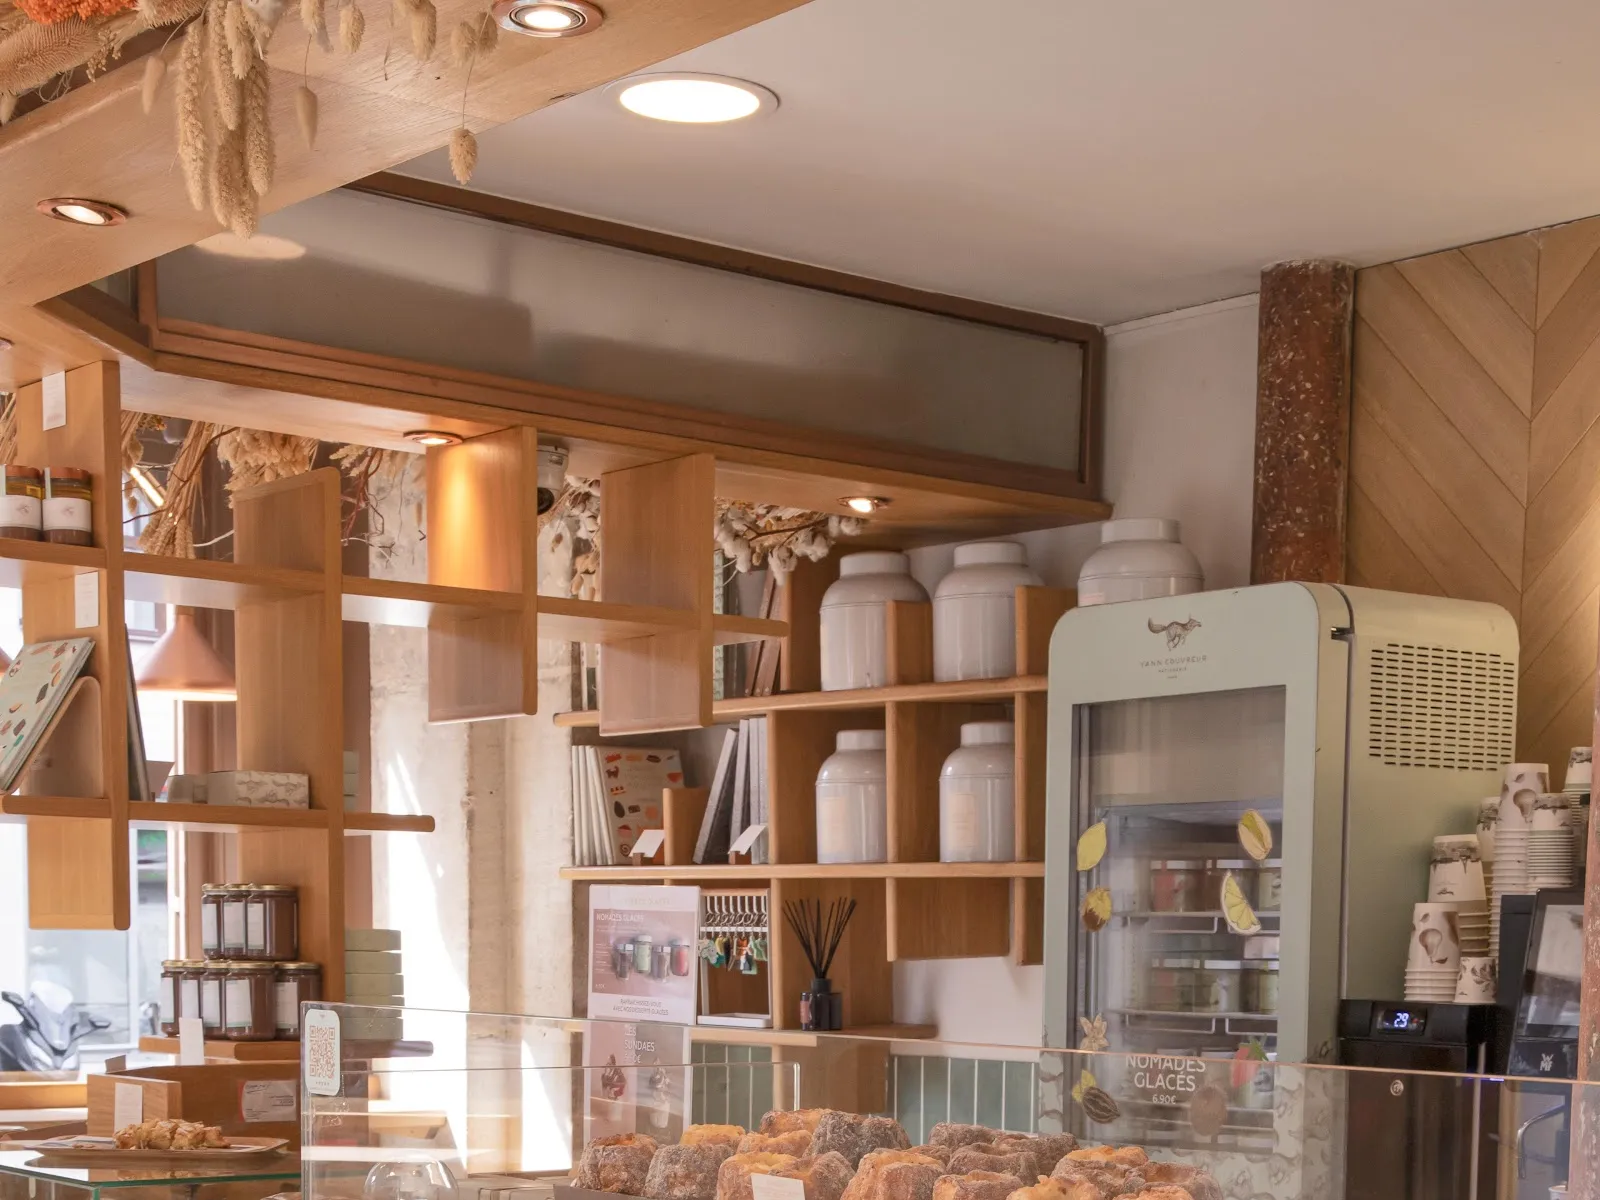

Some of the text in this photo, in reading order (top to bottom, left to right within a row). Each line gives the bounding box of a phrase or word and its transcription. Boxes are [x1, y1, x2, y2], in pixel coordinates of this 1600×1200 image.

[1140, 655, 1207, 668] YANN COUVREUR
[1394, 1012, 1410, 1028] 29
[624, 1040, 655, 1052] SUNDAES
[1126, 1054, 1206, 1073] NOMADES
[1540, 1053, 1555, 1072] WMF
[1134, 1071, 1196, 1092] GLACÉS
[1152, 1094, 1176, 1105] 6.90€
